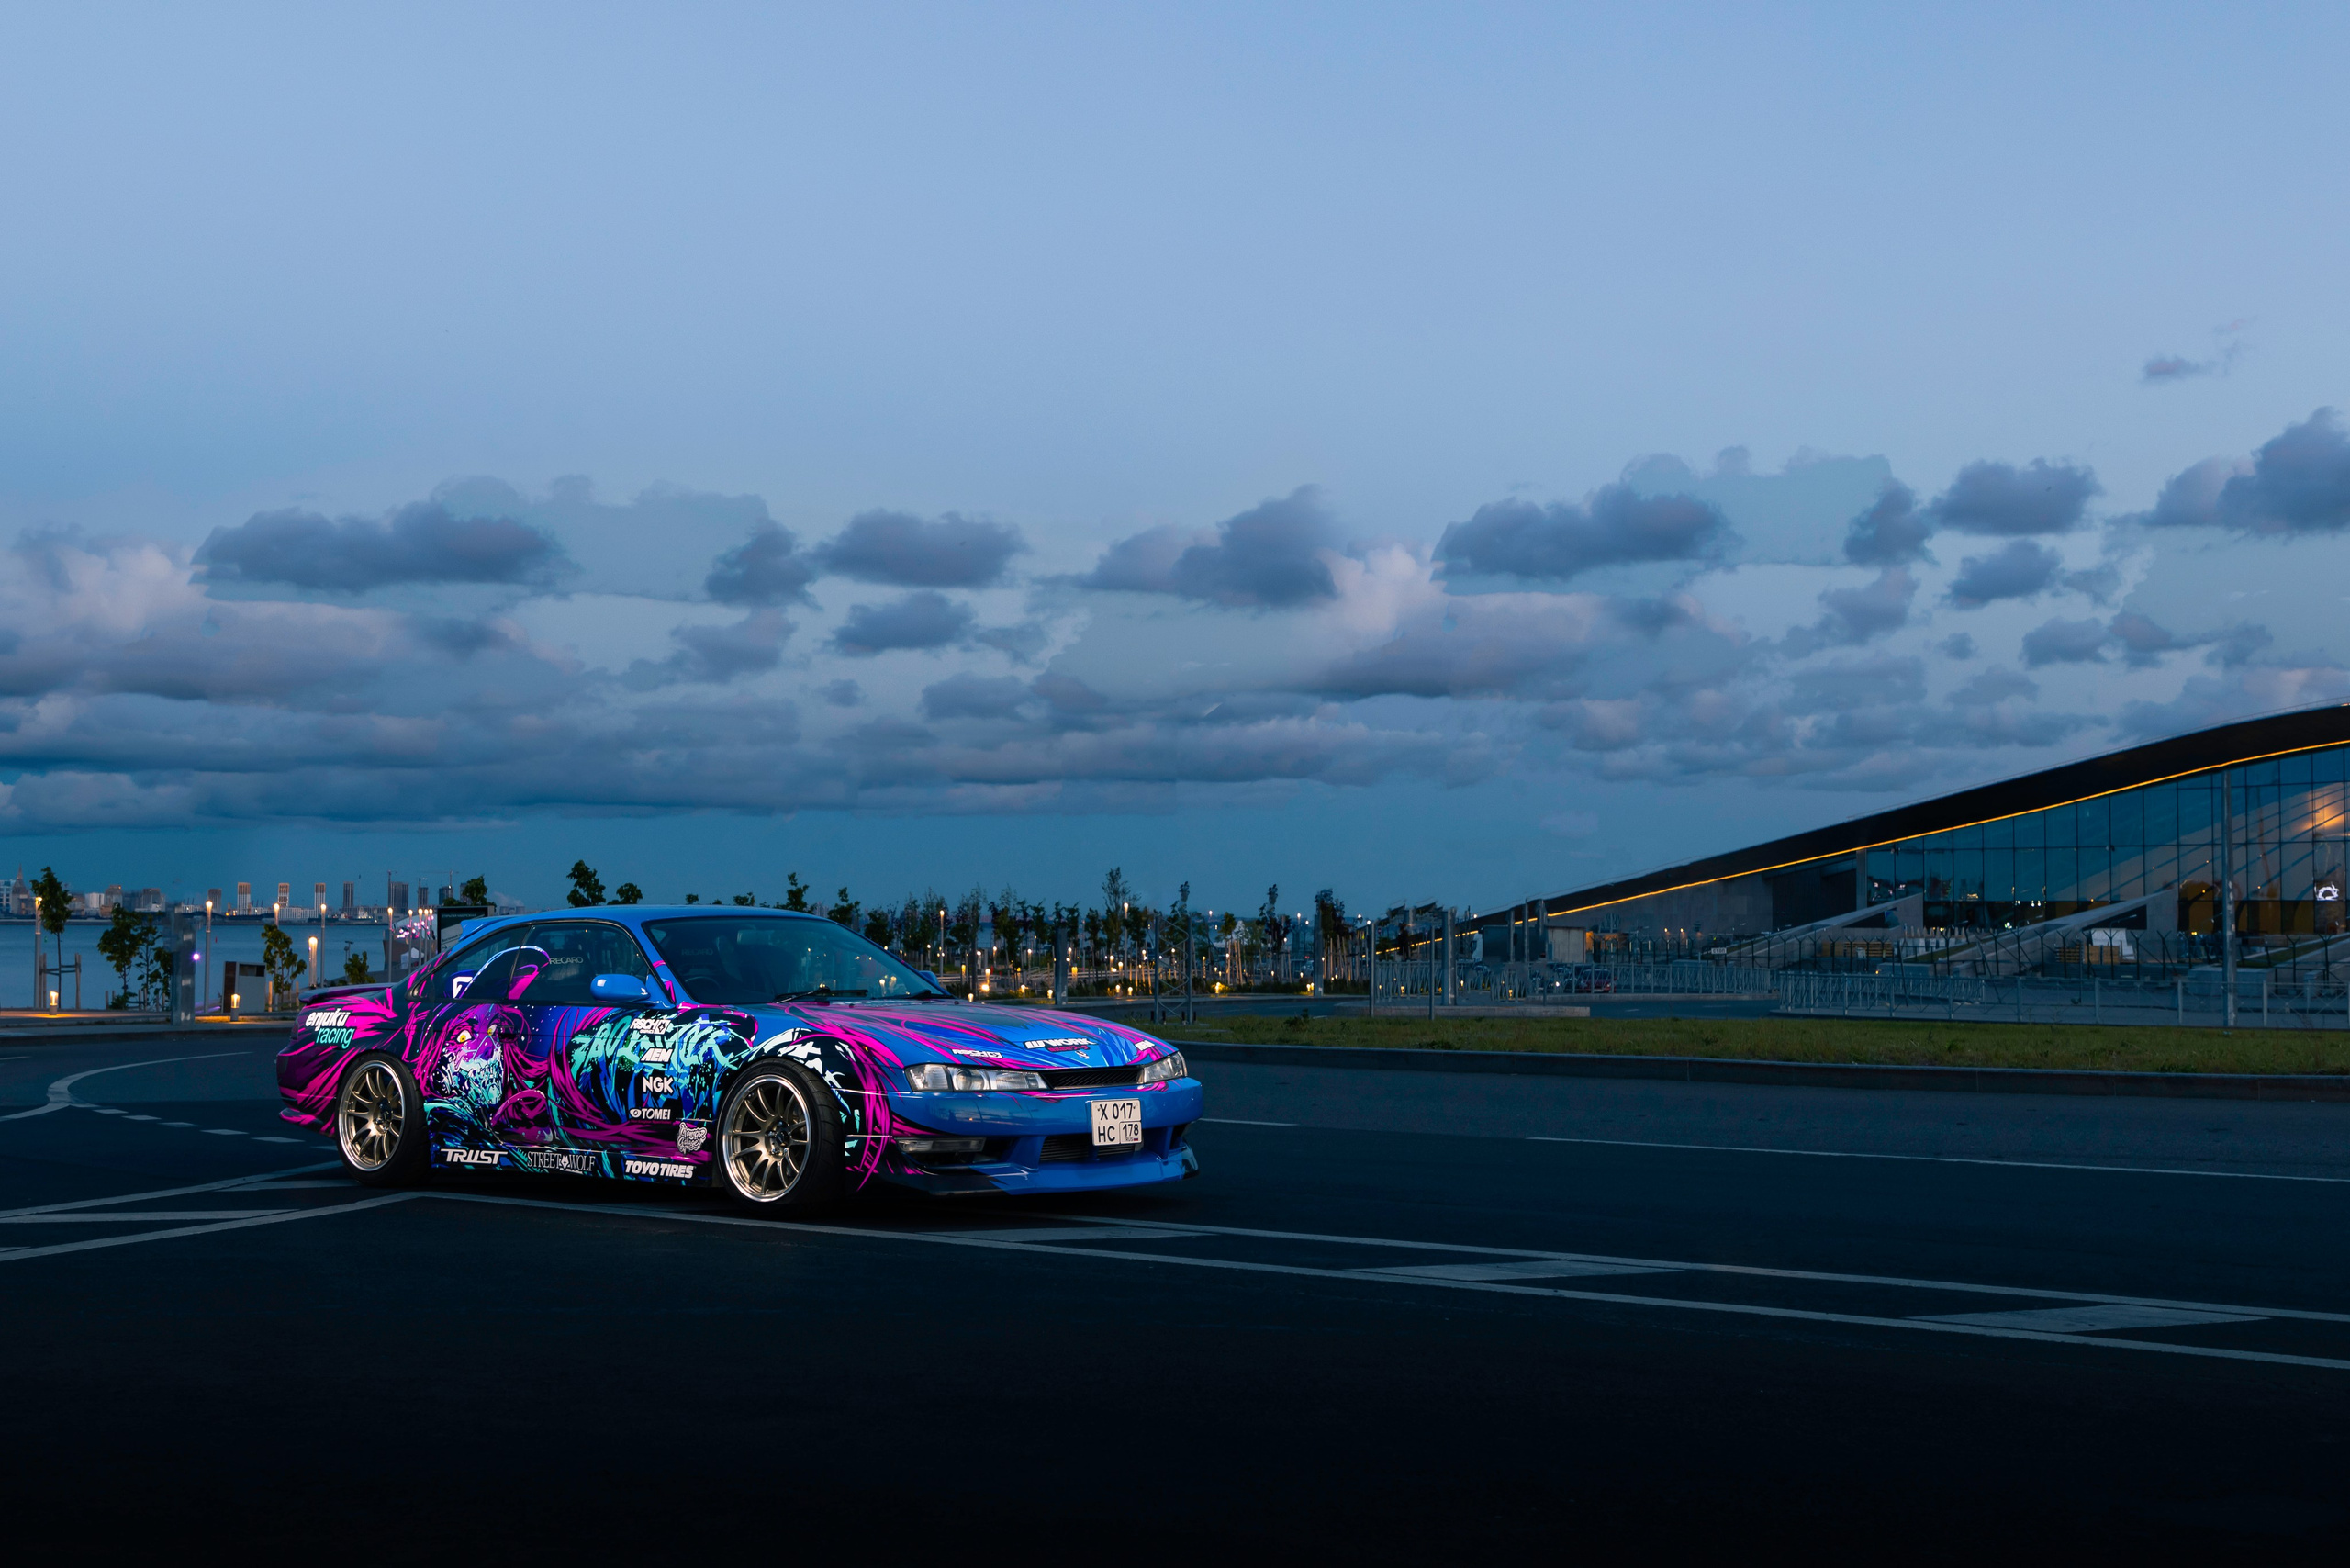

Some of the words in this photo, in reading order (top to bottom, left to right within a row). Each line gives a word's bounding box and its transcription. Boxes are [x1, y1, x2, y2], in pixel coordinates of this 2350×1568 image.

[549, 957, 584, 965] RECARO
[316, 1027, 355, 1049] racing
[1043, 1038, 1098, 1047] WORK
[640, 1047, 673, 1062] AEM
[643, 1076, 674, 1094] NGK
[642, 1108, 671, 1120] TOMEI
[1100, 1103, 1108, 1121] X
[1112, 1103, 1133, 1120] 017
[1098, 1126, 1115, 1143] HC
[1123, 1123, 1139, 1137] 178
[440, 1148, 508, 1165] TRUST
[527, 1151, 561, 1170] STREET
[569, 1154, 596, 1172] WOLF
[625, 1160, 660, 1176] TOYO
[660, 1163, 694, 1179] TIRES
